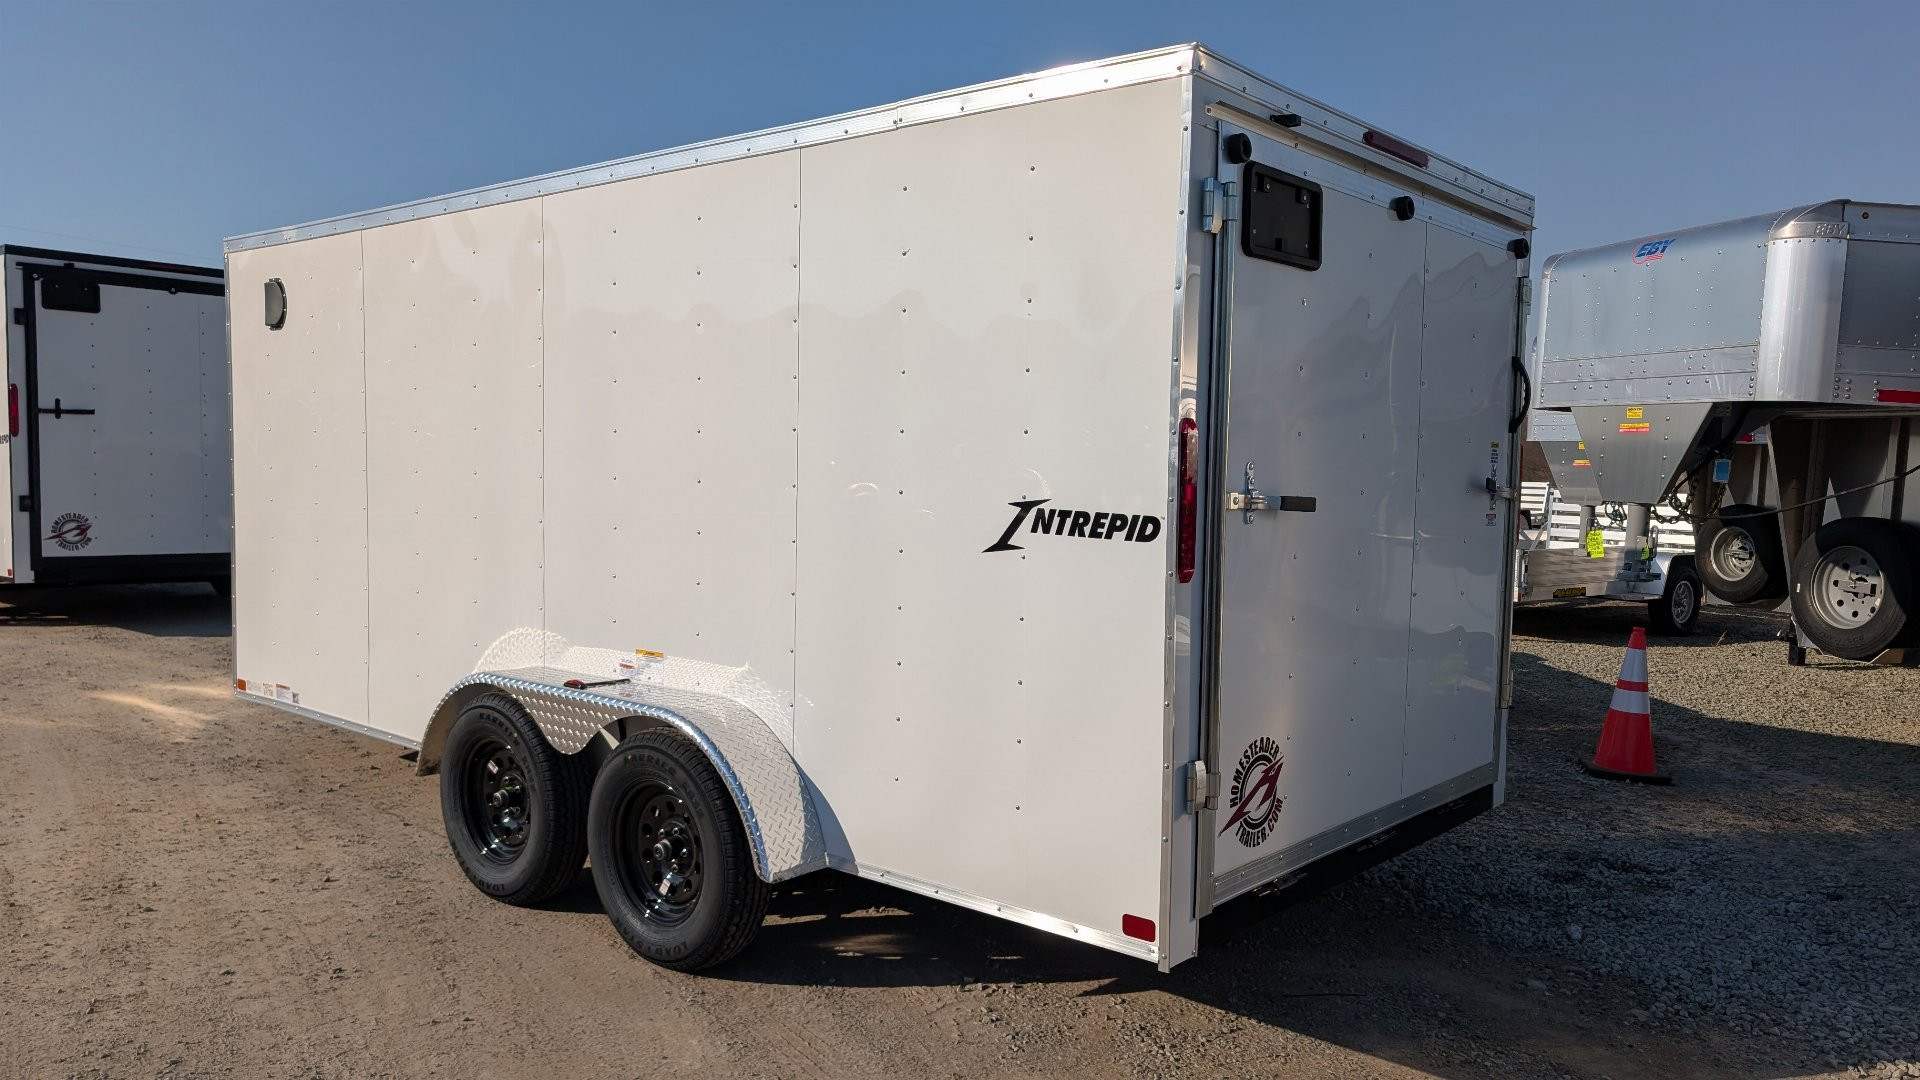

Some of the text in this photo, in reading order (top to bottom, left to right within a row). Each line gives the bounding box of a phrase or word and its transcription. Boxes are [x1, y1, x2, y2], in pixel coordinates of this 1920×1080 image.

[1635, 239, 1676, 258] EBY
[981, 499, 1162, 553] INTREPID
[1229, 736, 1280, 808] HOMESTEADER
[1235, 797, 1283, 848] TRAILER.COM
